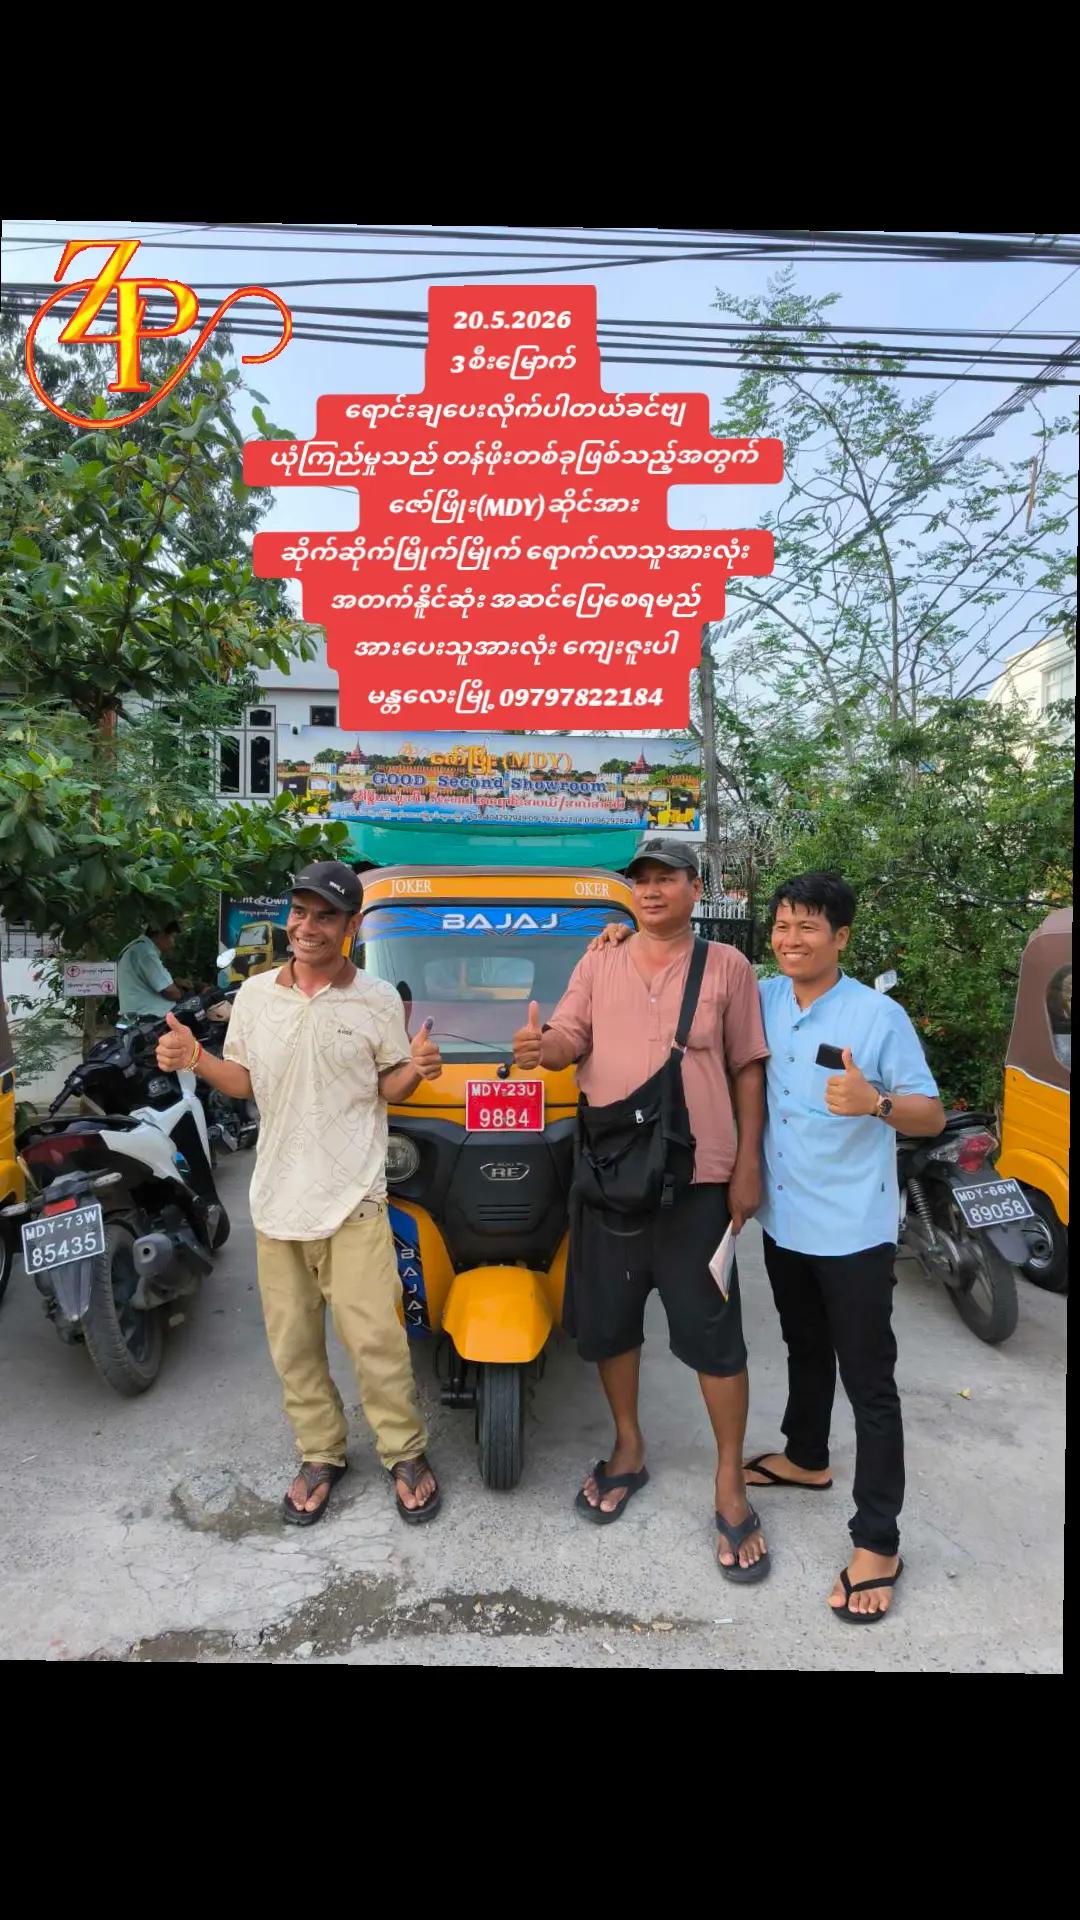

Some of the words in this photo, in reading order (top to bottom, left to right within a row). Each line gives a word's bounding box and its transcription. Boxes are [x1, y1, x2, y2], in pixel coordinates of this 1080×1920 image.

[502, 751, 573, 774] (MDY)
[372, 772, 426, 787] GOOD
[438, 775, 504, 790] Second
[510, 777, 608, 794] Showroom
[390, 880, 433, 898] JOKER
[574, 882, 610, 898] OKER
[442, 913, 558, 930] BAJAJ
[471, 1083, 537, 1097] MDY-23U
[479, 1108, 530, 1128] 9884
[491, 1168, 520, 1178] RE
[957, 1183, 1017, 1202] MDY-66W
[970, 1200, 1025, 1223] 89058
[26, 1210, 97, 1241] MDY-73W
[32, 1232, 97, 1267] 85435
